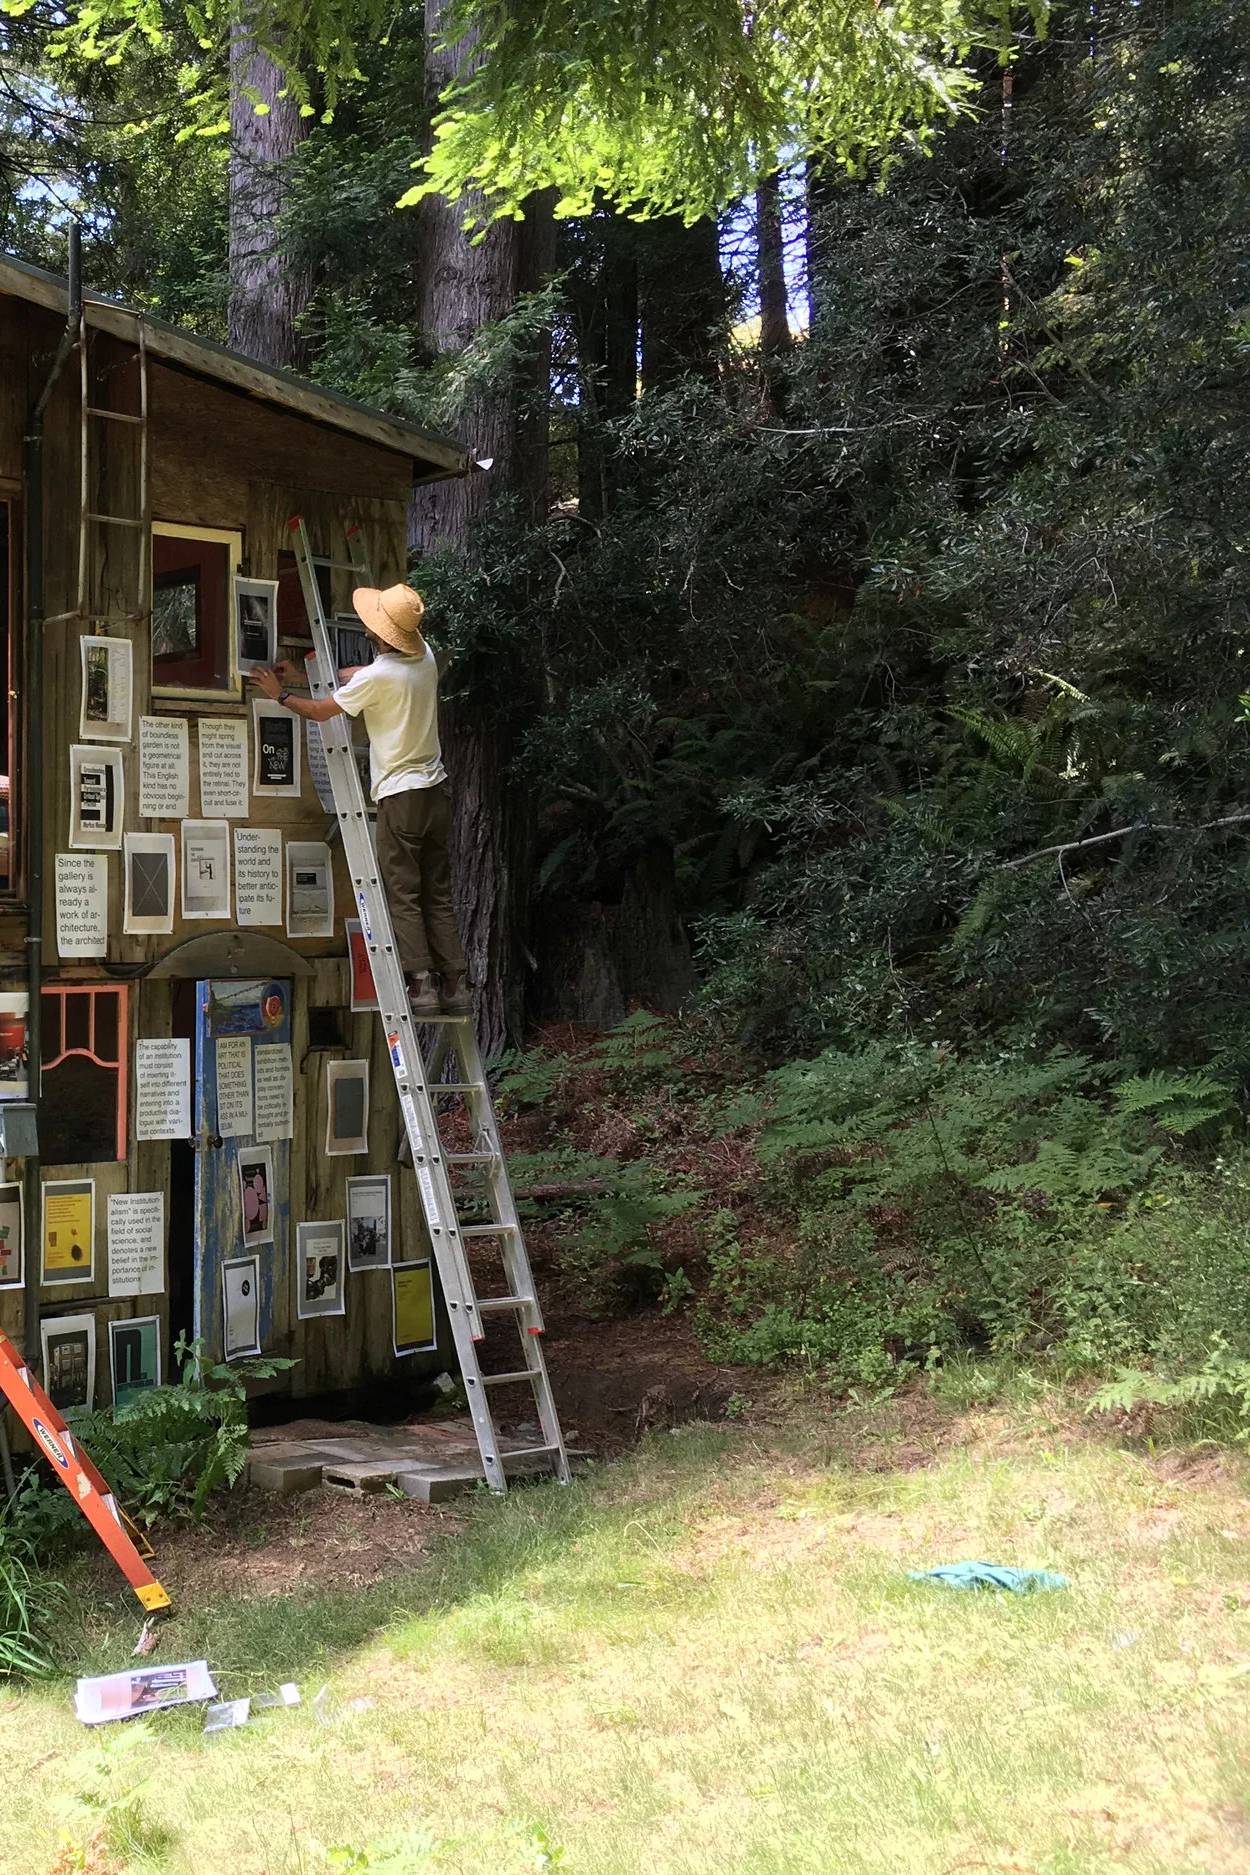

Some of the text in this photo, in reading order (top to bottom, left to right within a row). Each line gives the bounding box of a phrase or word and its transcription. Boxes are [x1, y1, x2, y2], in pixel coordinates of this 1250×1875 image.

[142, 720, 153, 728] The
[155, 721, 170, 729] other
[202, 723, 235, 732] Though they
[150, 731, 179, 739] boundless
[142, 742, 163, 750] garden
[262, 744, 275, 754] On
[148, 752, 181, 760] geometrical
[143, 762, 160, 770] figure
[209, 761, 220, 769] they
[157, 772, 178, 781] English
[232, 780, 246, 788] They
[167, 793, 185, 801] begin-
[143, 803, 156, 811] ning
[237, 833, 261, 841] Under-
[237, 845, 279, 855] standing the
[58, 859, 95, 868] Since the
[258, 857, 270, 865] and
[58, 872, 85, 882] gallery
[247, 870, 270, 879] history
[272, 870, 278, 878] to
[59, 885, 97, 895] always al-
[238, 882, 258, 890] better
[59, 898, 82, 908] ready
[238, 894, 275, 904] ipate its fu-
[60, 911, 79, 919] work
[81, 910, 88, 919] of
[238, 907, 251, 915] ture
[60, 924, 100, 933] chitecture,
[60, 936, 105, 945] the architect
[151, 1043, 177, 1051] capability
[218, 1071, 245, 1080] THAT DOES
[162, 1080, 187, 1088] different
[219, 1081, 247, 1090] SOMETHING
[219, 1092, 235, 1100] OTHER
[139, 1109, 167, 1117] productive
[111, 1218, 126, 1226] cally
[128, 1217, 144, 1225] used
[111, 1227, 125, 1235] field
[135, 1226, 152, 1234] social
[112, 1266, 140, 1275] portance
[40, 1428, 63, 1458] WERNER
